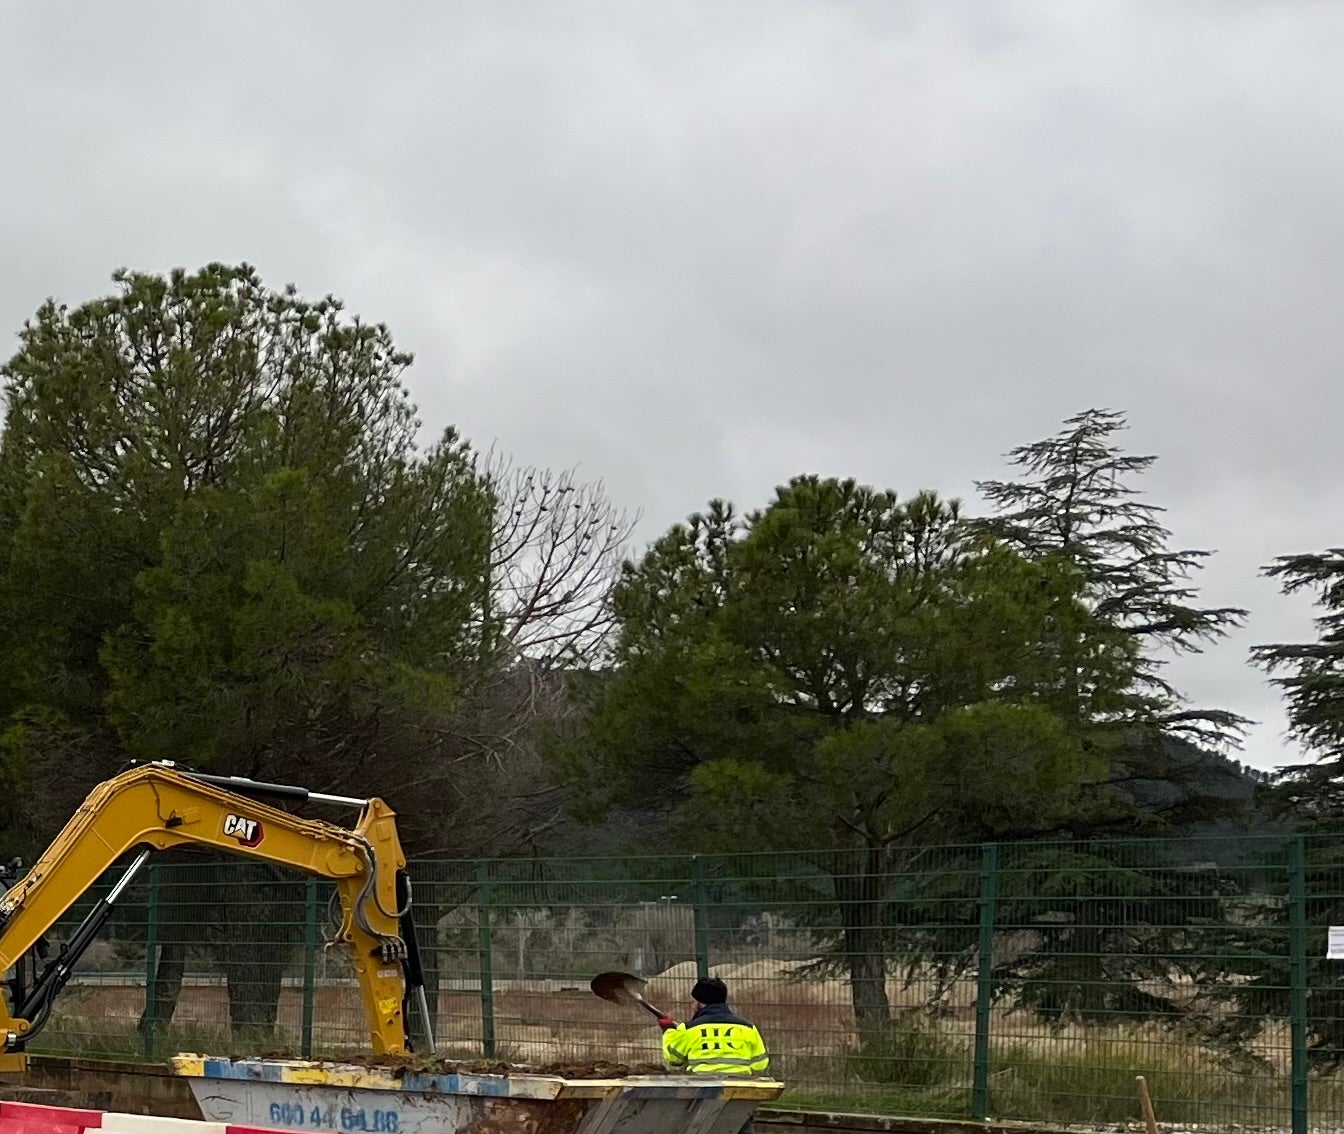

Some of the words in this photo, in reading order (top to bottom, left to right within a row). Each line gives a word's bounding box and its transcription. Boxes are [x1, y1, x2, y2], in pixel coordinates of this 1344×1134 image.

[223, 813, 257, 841] CAT
[700, 1026, 744, 1051] HC
[269, 1102, 305, 1126] 600
